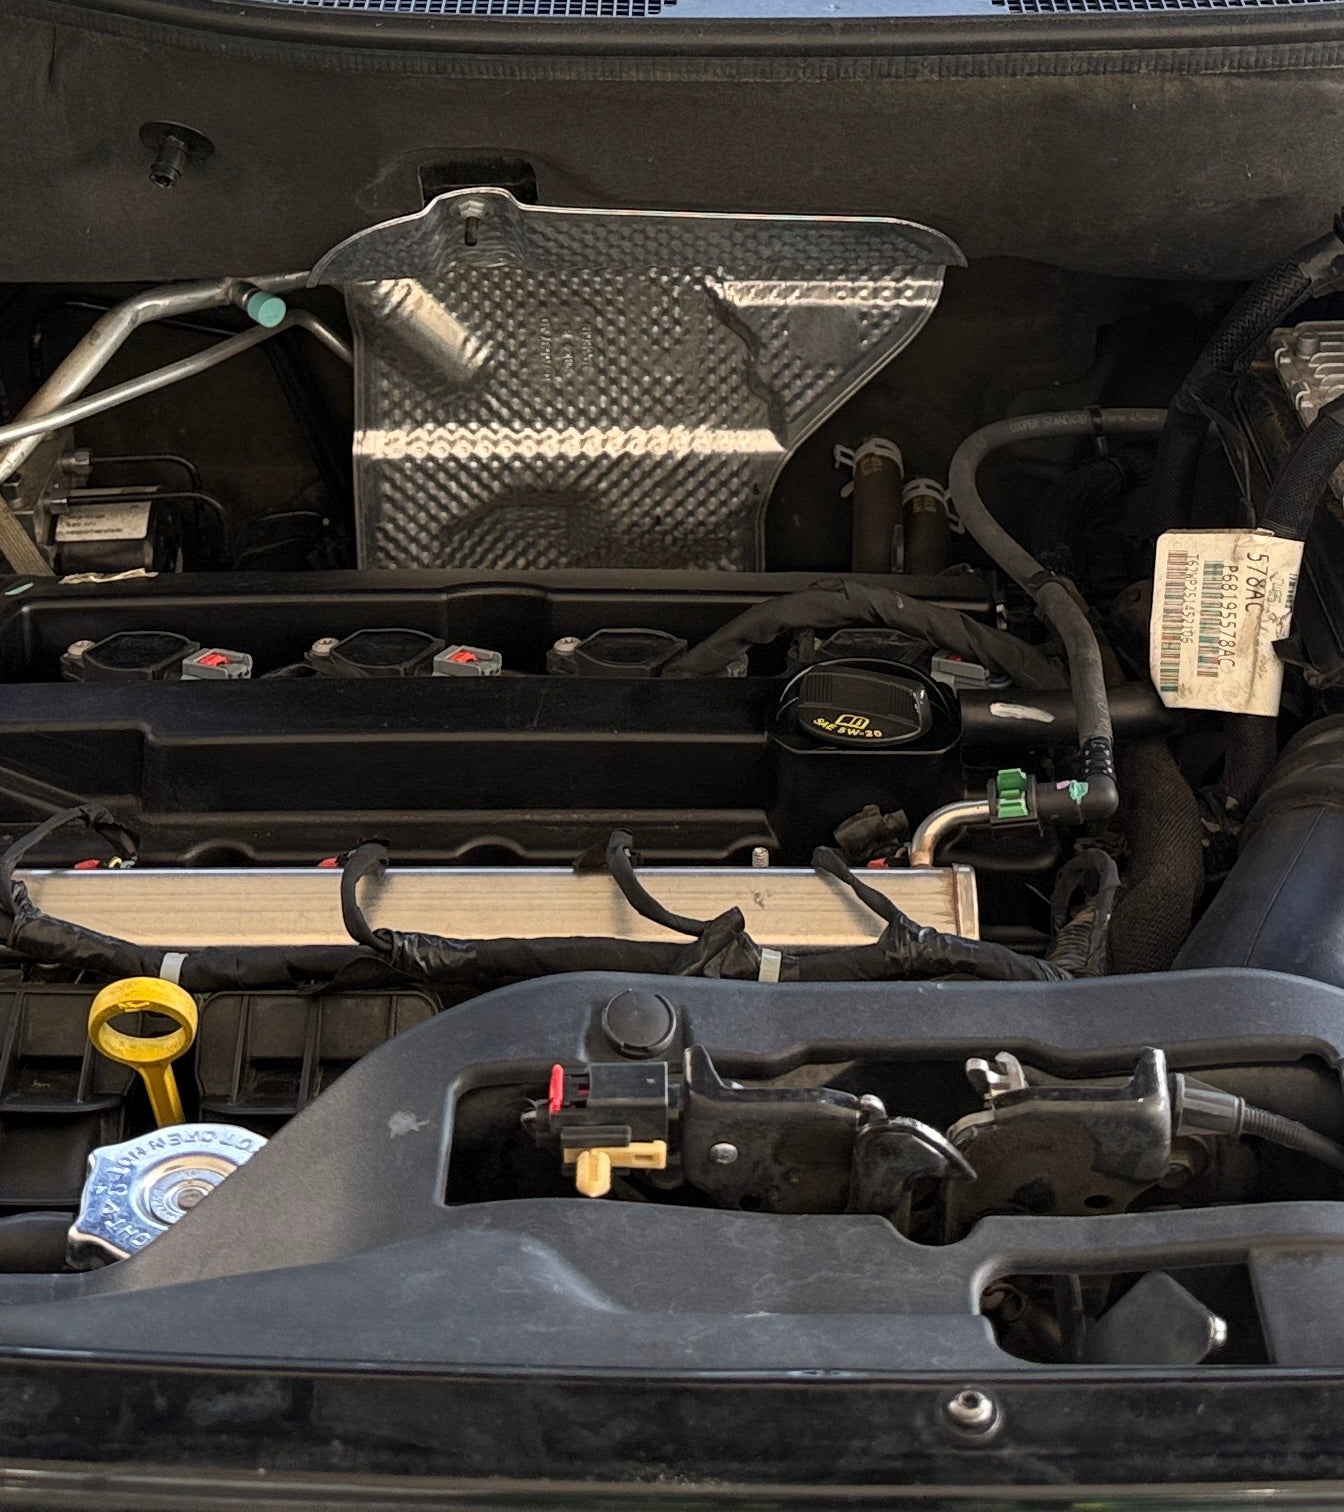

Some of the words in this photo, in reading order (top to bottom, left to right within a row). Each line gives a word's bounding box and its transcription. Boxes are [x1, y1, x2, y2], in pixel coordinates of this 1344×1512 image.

[1245, 552, 1270, 612] 578AC
[1218, 565, 1239, 667] P68195578AC
[813, 717, 837, 731] SAE
[837, 727, 883, 738] 5W-20
